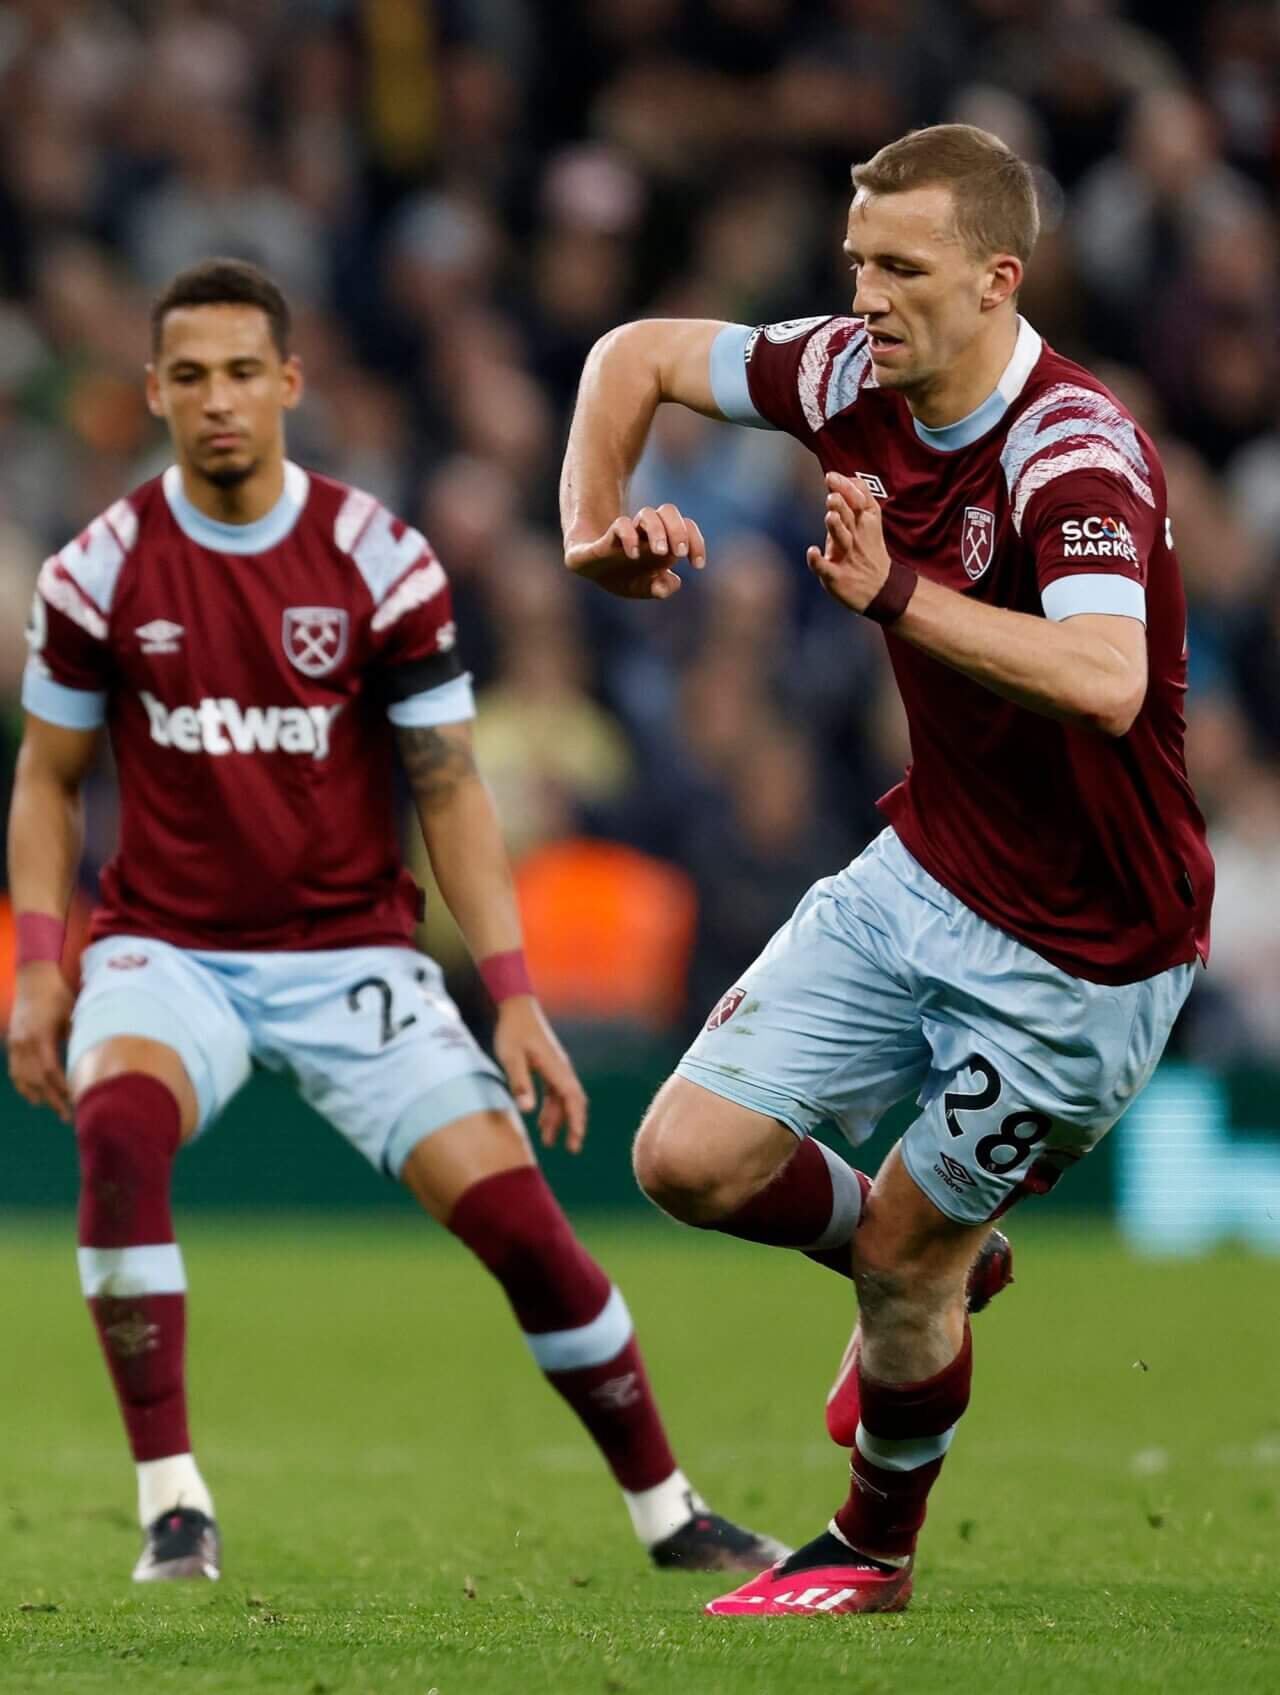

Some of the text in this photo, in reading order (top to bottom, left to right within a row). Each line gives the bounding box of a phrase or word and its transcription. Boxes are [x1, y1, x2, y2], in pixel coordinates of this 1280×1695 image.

[1063, 540, 1140, 569] MARKET
[139, 690, 345, 761] betway
[944, 1052, 1053, 1176] 28
[932, 1163, 964, 1195] umbro
